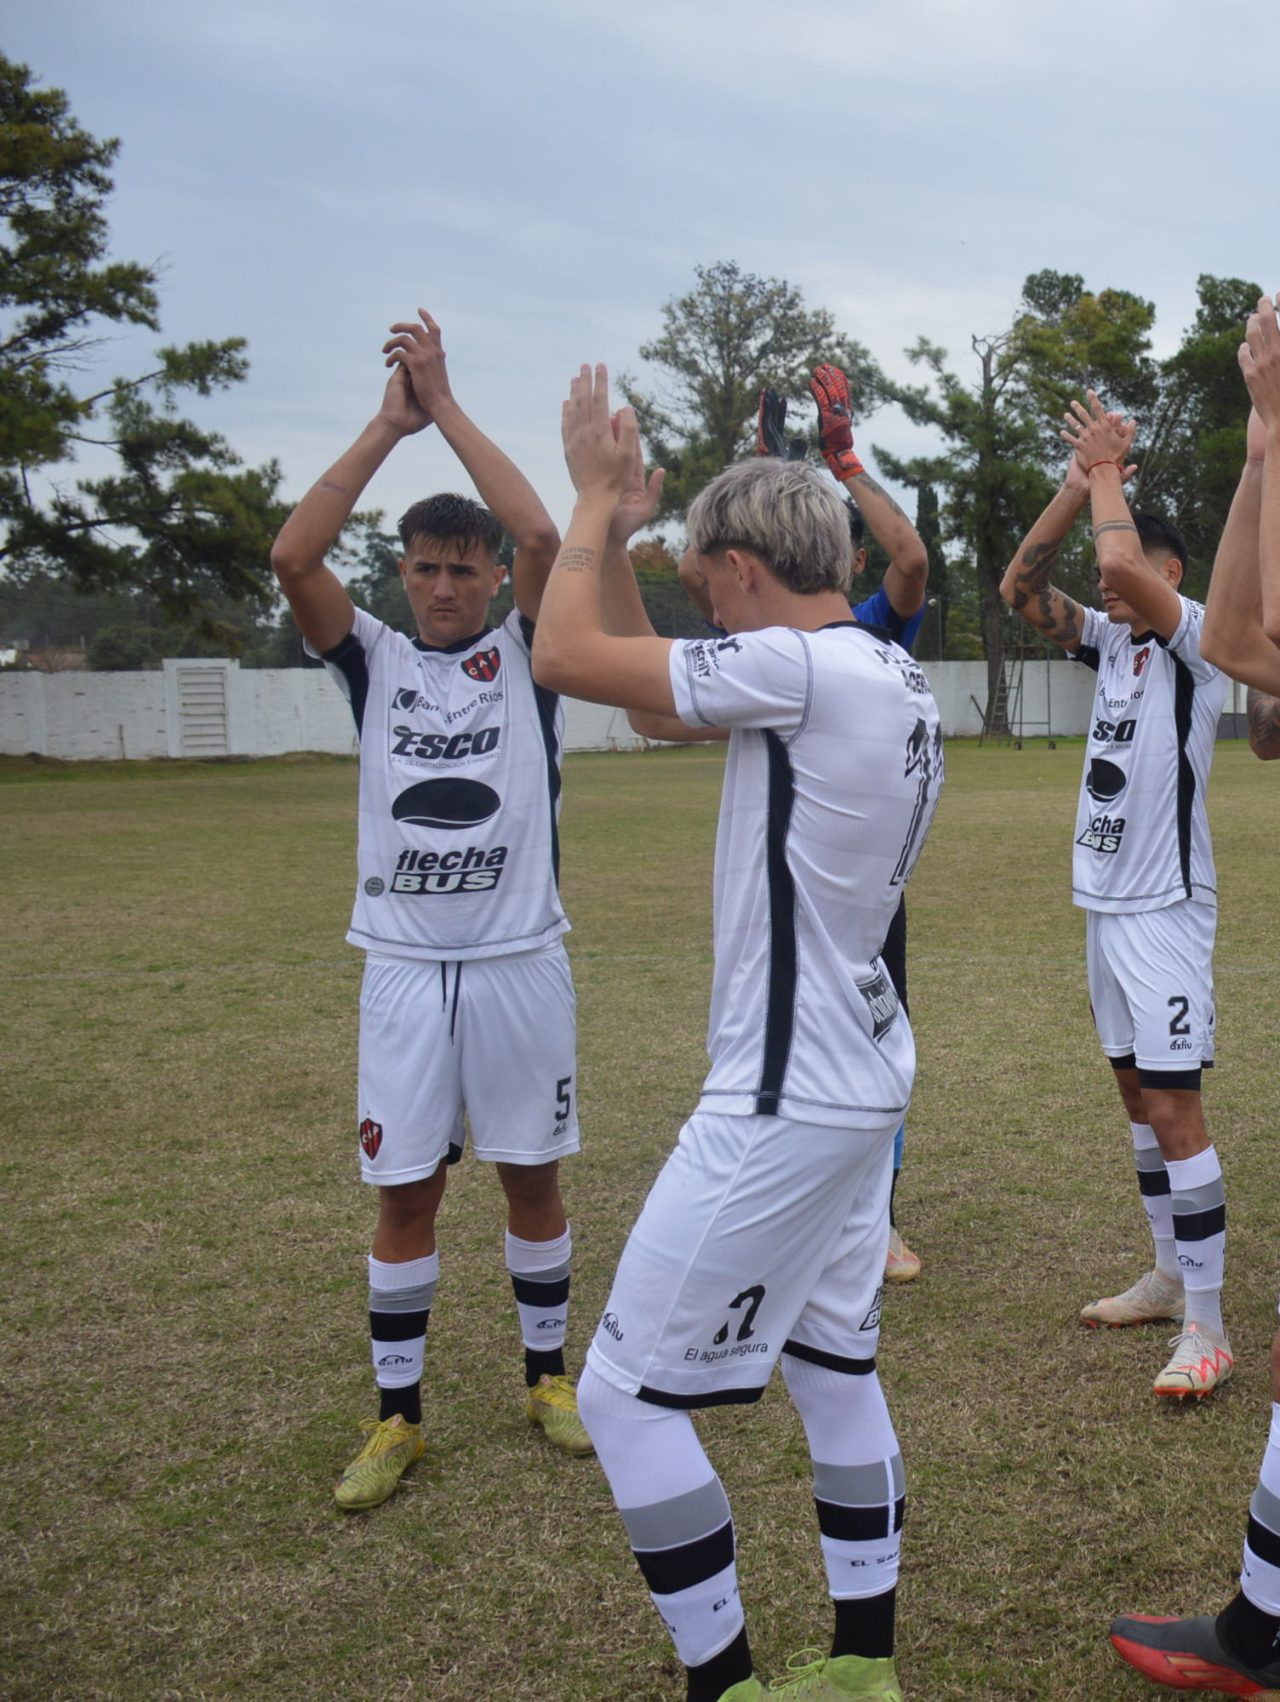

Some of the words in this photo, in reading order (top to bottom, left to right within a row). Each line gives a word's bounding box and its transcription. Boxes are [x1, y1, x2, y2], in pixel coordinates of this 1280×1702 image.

[397, 846, 508, 871] flecha
[393, 870, 497, 893] BUS
[1167, 996, 1191, 1036] 2
[555, 1076, 572, 1121] 5
[684, 1347, 699, 1361] El
[700, 1349, 729, 1363] agua
[729, 1342, 769, 1357] segura
